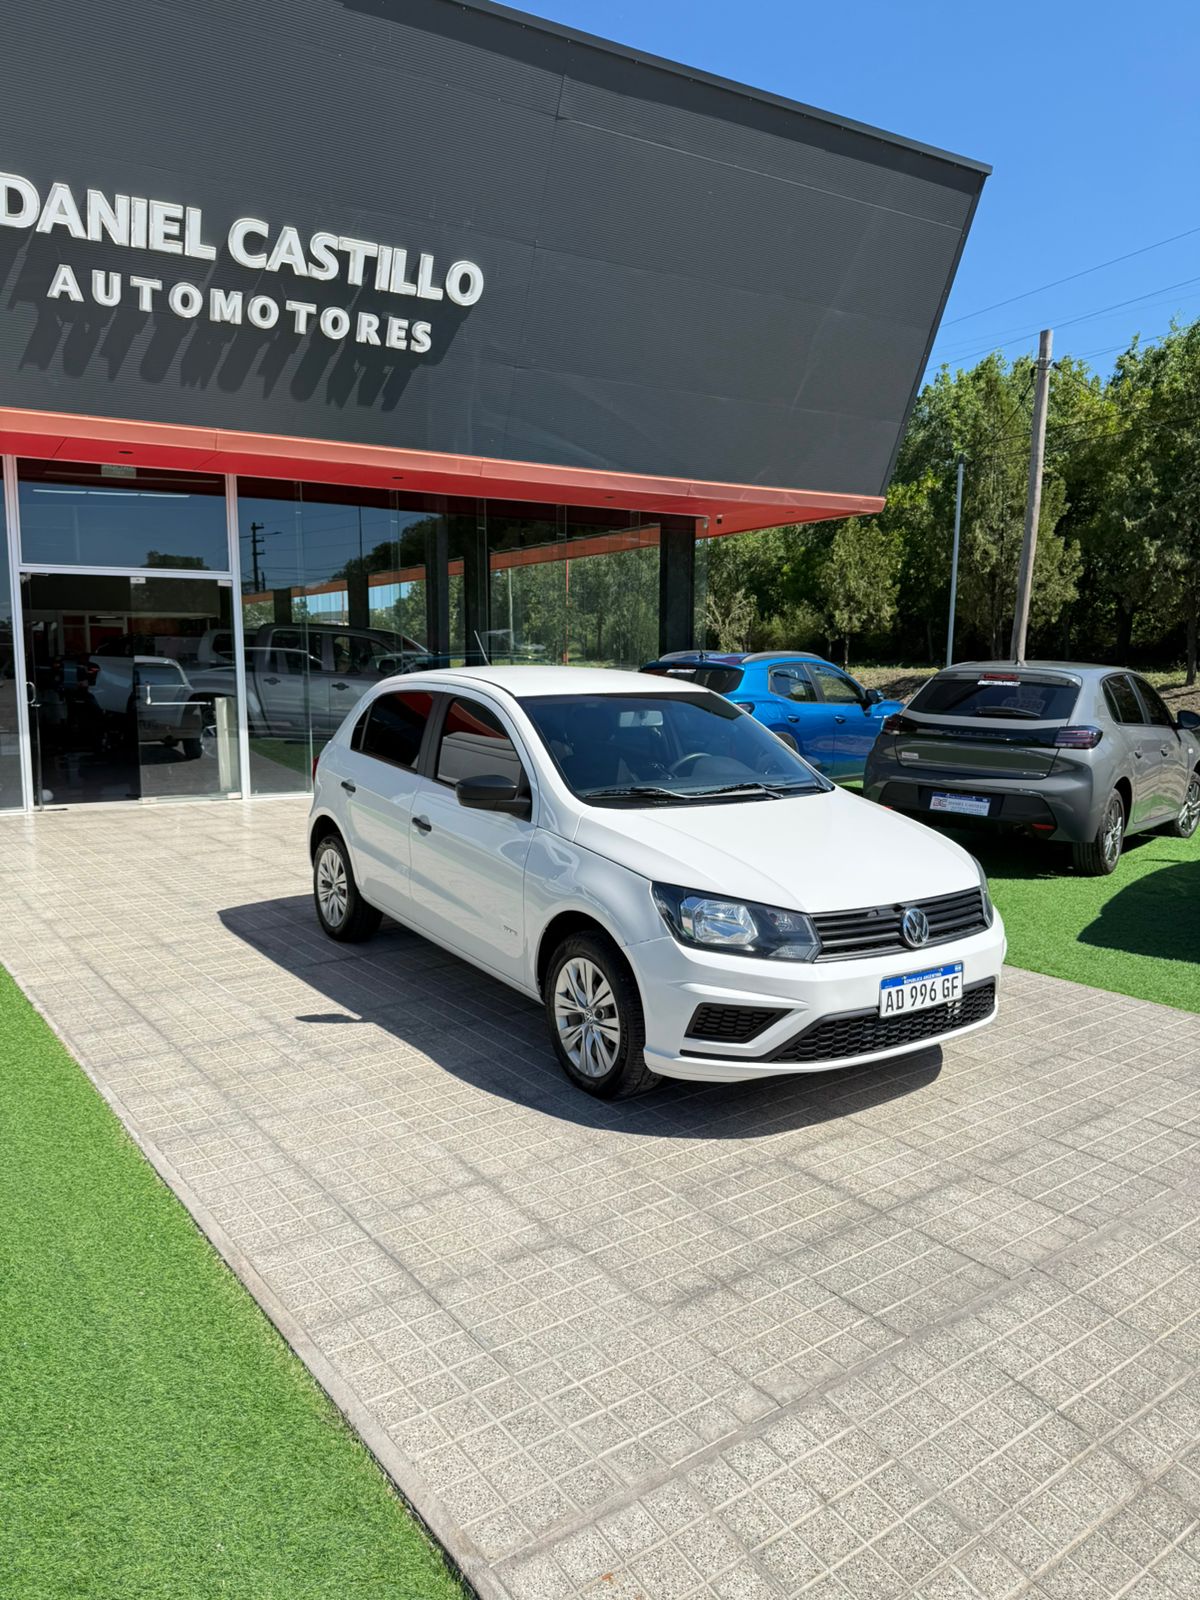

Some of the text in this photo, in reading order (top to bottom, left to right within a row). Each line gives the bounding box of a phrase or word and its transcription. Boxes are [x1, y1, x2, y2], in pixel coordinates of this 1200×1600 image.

[0, 171, 484, 306] DANIEL CASTILLO
[46, 264, 432, 354] AUTOMOTORES
[886, 975, 959, 1012] AD 996 GF
